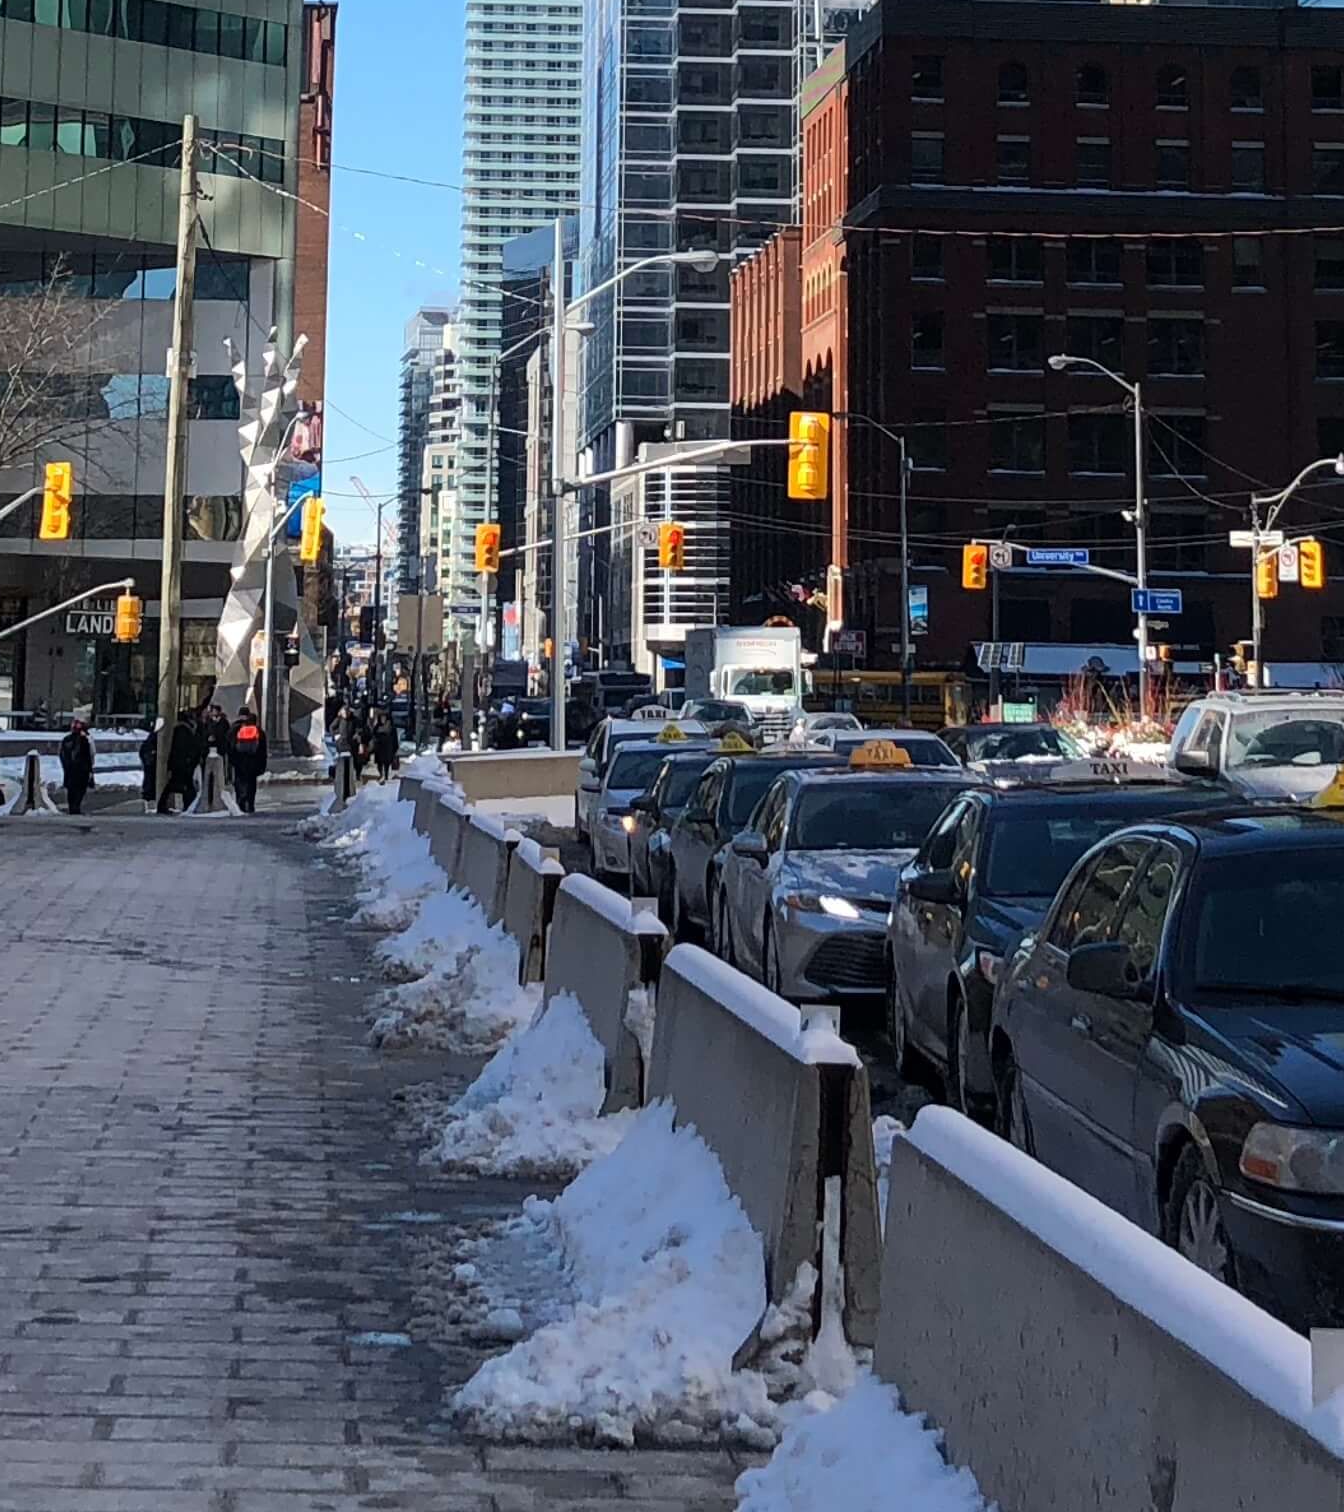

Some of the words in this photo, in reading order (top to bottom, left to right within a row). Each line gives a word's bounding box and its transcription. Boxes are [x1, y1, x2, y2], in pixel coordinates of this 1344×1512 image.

[66, 614, 143, 637] LAND
[866, 748, 894, 761] TAXI
[1089, 762, 1129, 775] TAXI
